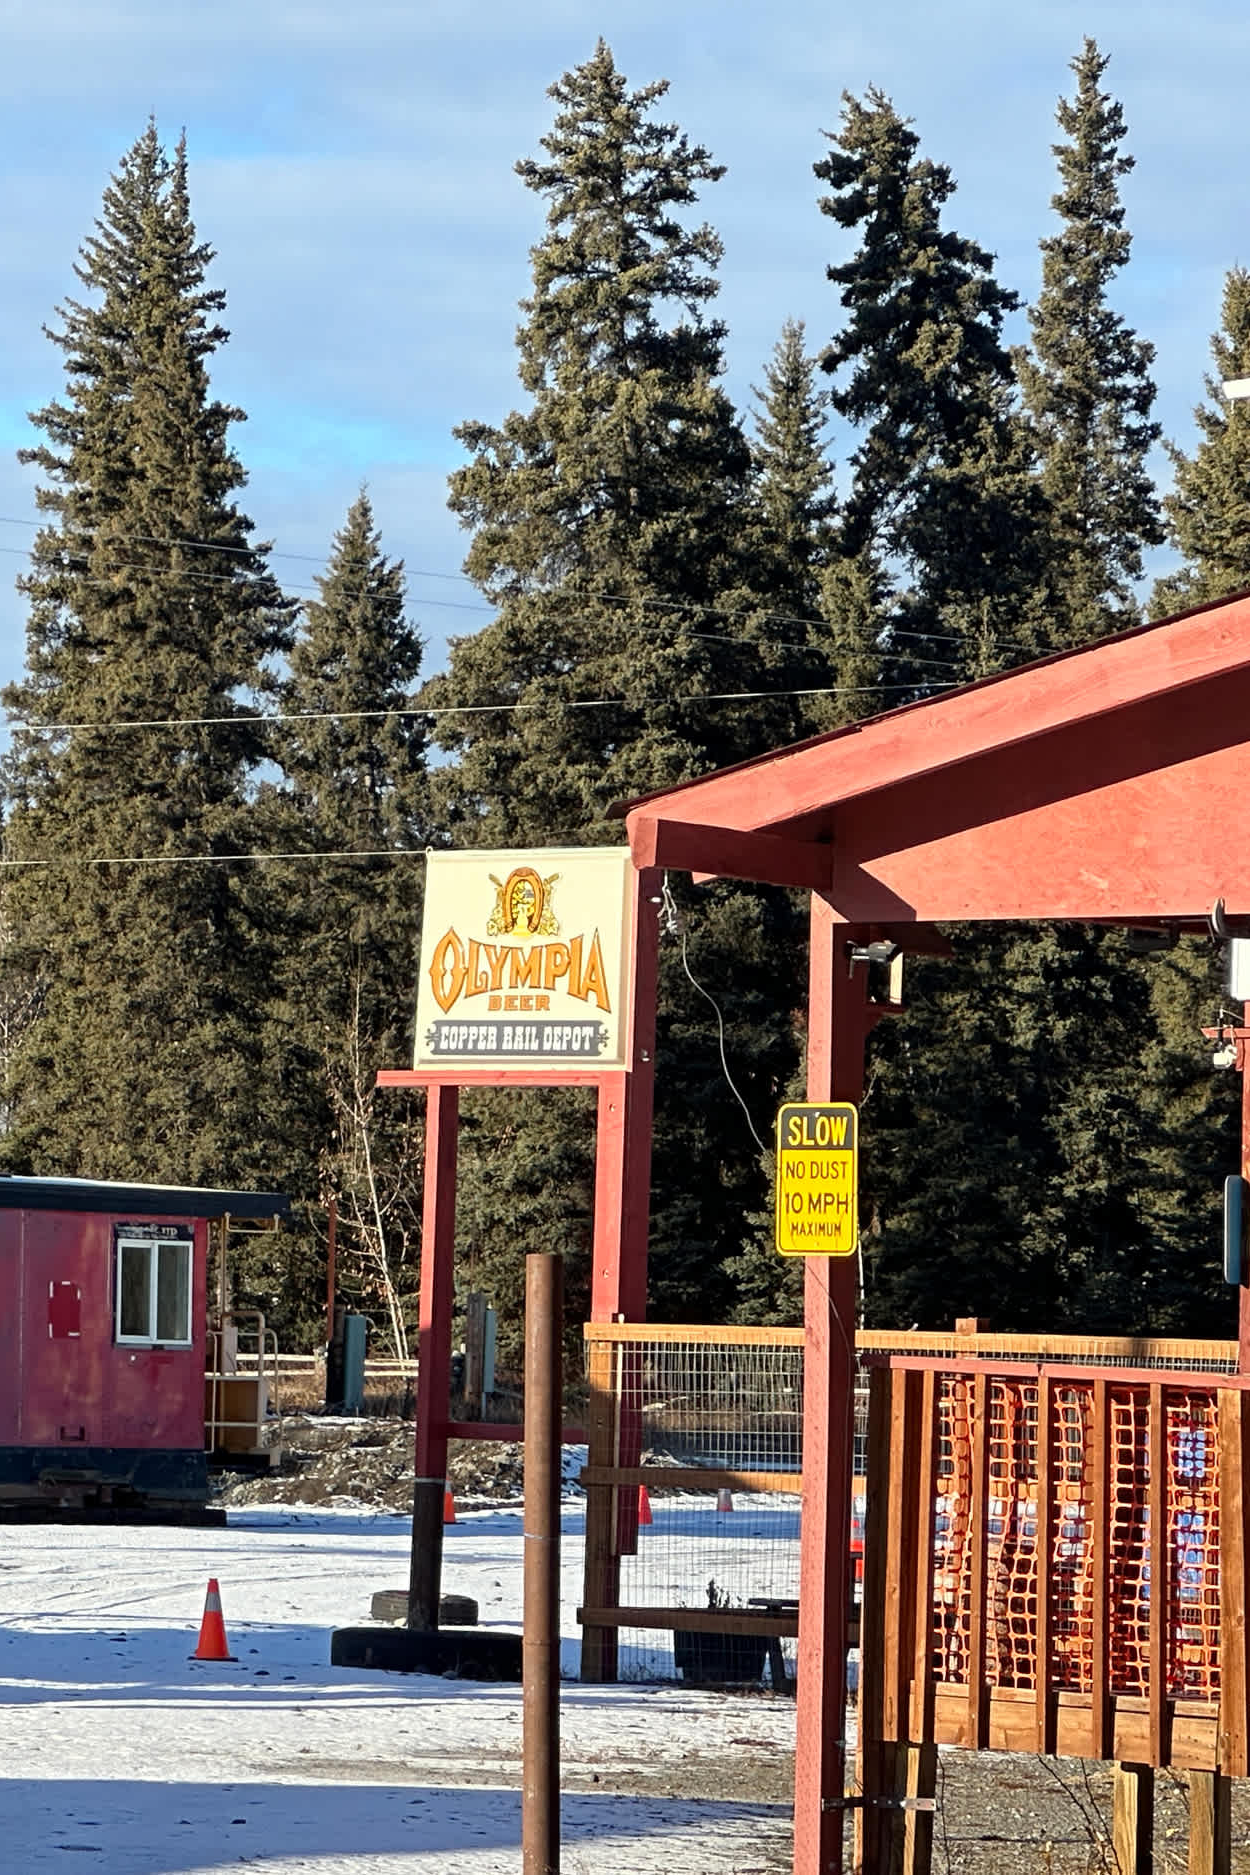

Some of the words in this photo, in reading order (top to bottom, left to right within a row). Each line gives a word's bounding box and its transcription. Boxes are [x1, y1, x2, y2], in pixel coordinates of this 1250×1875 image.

[429, 927, 612, 1015] OLYMPIA
[488, 995, 550, 1011] BEER
[439, 1025, 498, 1050] COPPER
[501, 1026, 539, 1051] RAIL
[542, 1026, 595, 1051] DEPOT
[788, 1116, 848, 1146] SLOW
[785, 1161, 805, 1179] NO
[810, 1161, 847, 1179] DUST
[785, 1192, 803, 1214] 10
[808, 1192, 849, 1215] MPH
[791, 1221, 841, 1236] MAXIMUM
